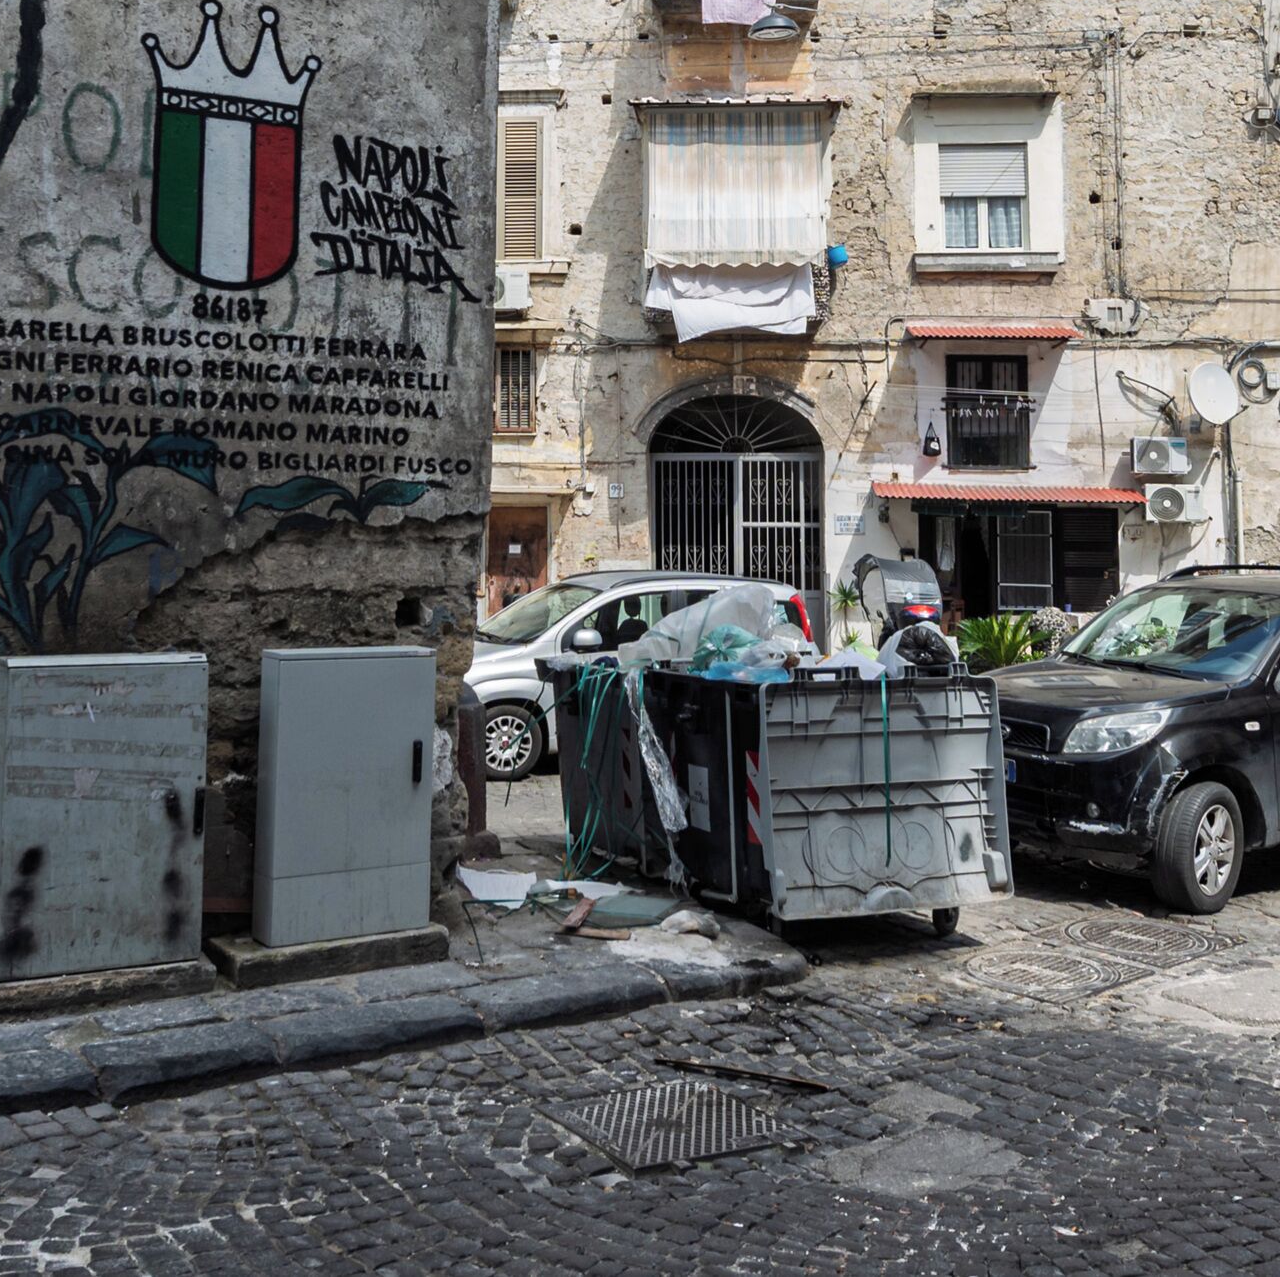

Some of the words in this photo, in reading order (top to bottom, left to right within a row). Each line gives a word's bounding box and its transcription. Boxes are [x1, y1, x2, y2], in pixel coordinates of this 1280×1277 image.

[122, 325, 306, 354] BRUSCOLOTTI
[313, 336, 427, 361] FERRARA
[54, 352, 193, 378] FERRARIO
[201, 359, 300, 384] RENICA
[306, 366, 449, 392] CAFFARELLI
[12, 382, 119, 406] NAPOLI
[128, 388, 280, 413] GIORDANO
[288, 394, 441, 420] MARADONA
[172, 417, 297, 442] ROMANO
[306, 423, 410, 447] MARINO
[167, 448, 249, 471] MURO
[257, 450, 385, 474] BIGLIARDI
[393, 455, 472, 475] FUSCO
